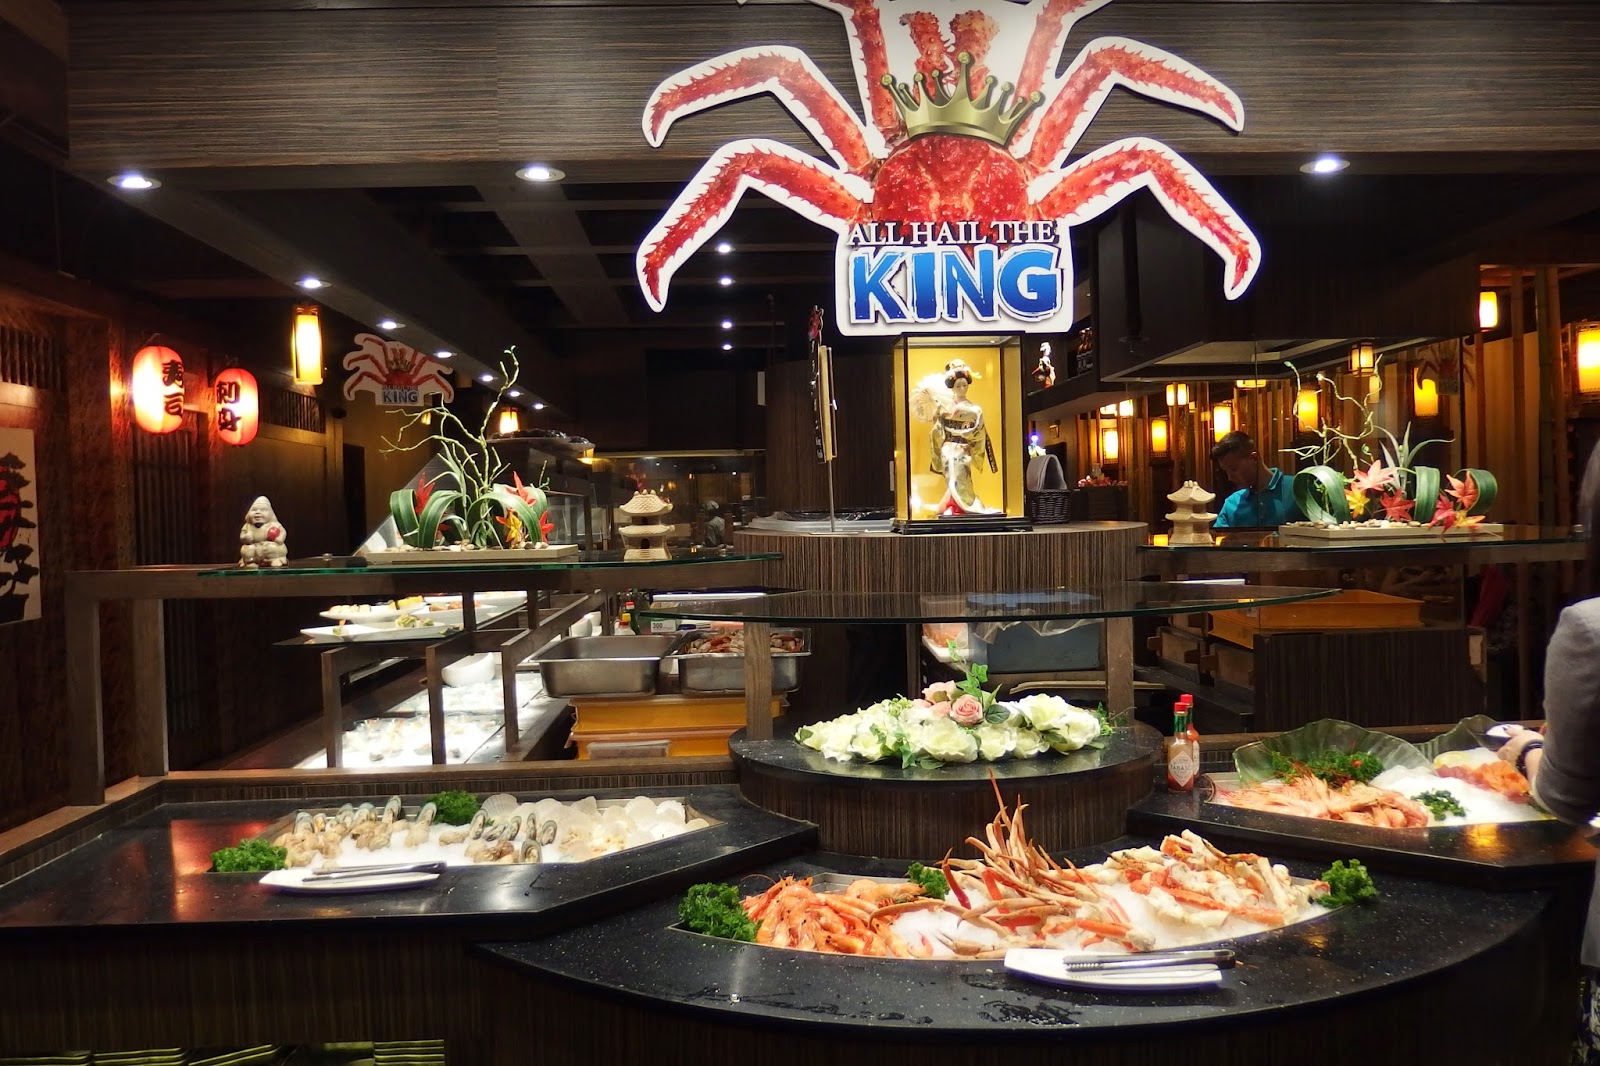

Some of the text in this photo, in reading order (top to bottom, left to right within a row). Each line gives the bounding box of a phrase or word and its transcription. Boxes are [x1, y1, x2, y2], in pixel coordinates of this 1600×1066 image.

[847, 220, 1057, 245] ALL HAIL THE
[850, 246, 1061, 322] KING
[383, 390, 418, 404] KING
